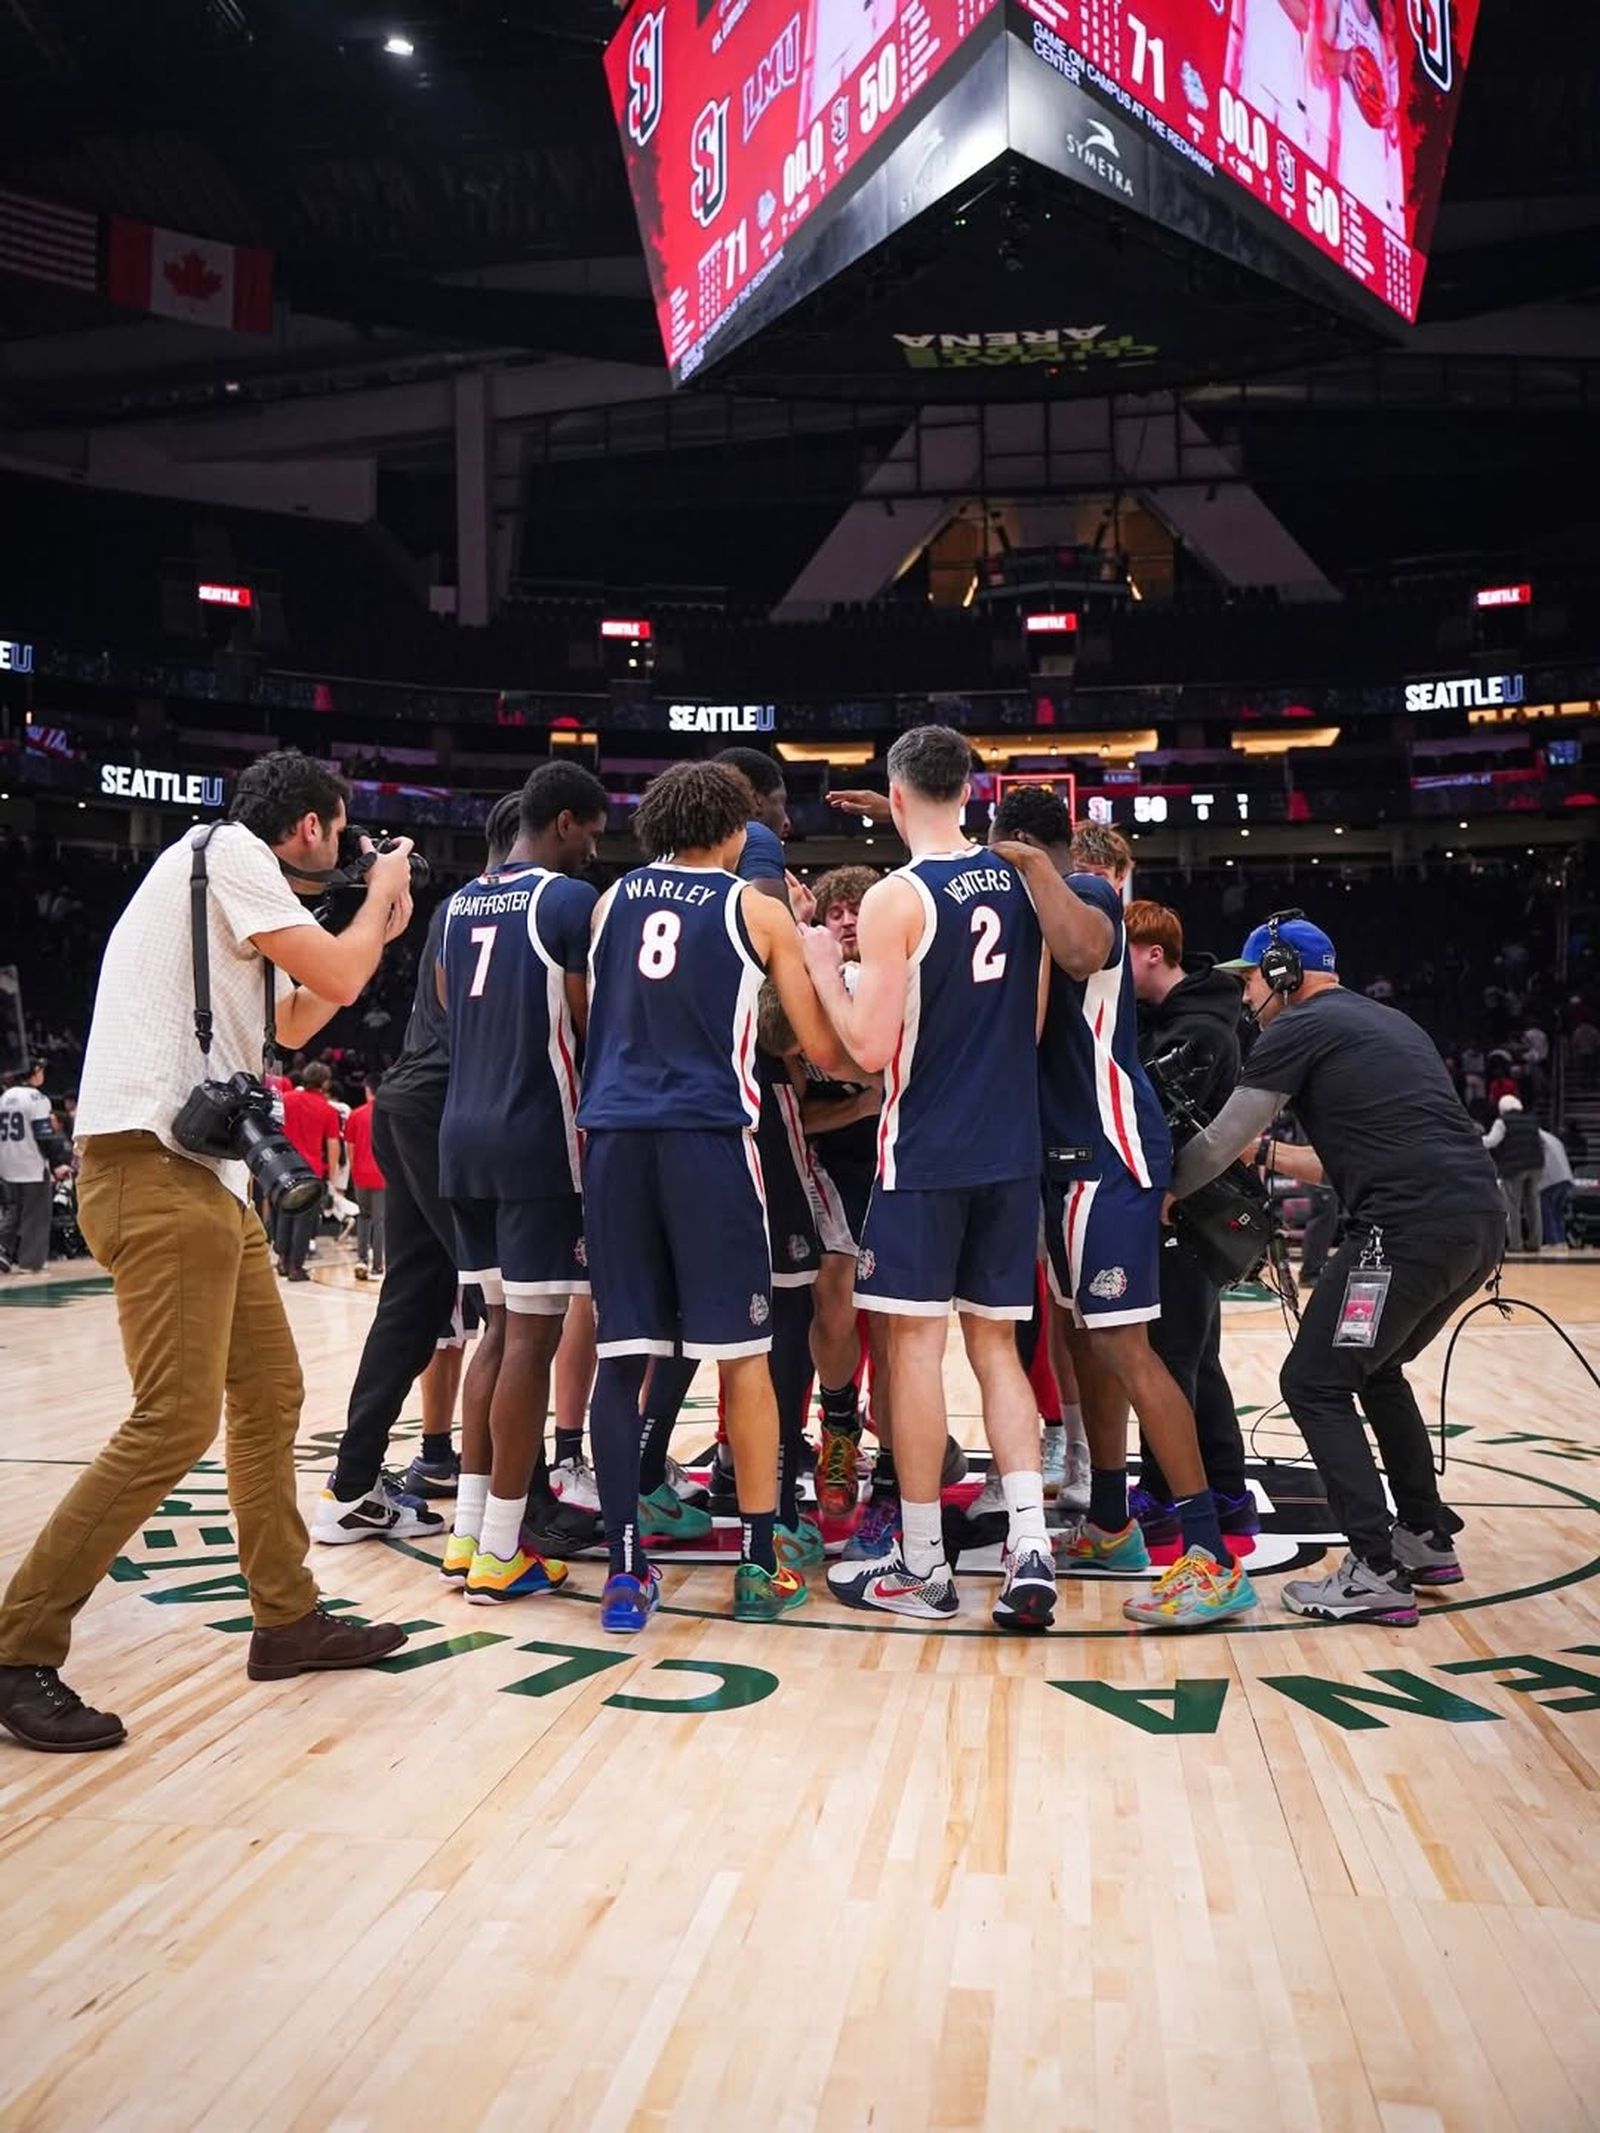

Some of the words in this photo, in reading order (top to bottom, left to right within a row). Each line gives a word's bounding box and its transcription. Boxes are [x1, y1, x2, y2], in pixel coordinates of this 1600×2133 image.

[743, 12, 800, 144] LMU
[859, 43, 897, 134] 50
[1033, 38, 1081, 85] CENTER
[1127, 13, 1165, 103] 71
[1033, 21, 1067, 58] GAME
[1068, 49, 1085, 73] ON
[1086, 64, 1131, 110] CAMPUS
[1131, 100, 1144, 119] AT
[1145, 110, 1167, 138] THE
[1166, 130, 1215, 177] REDHAWK
[1219, 86, 1269, 172] 00.0
[783, 120, 824, 207] 00.0
[1066, 132, 1134, 197] SYMETRA
[1305, 169, 1341, 247] 50
[724, 217, 747, 290] 71
[893, 324, 1107, 348] ARENA
[669, 705, 775, 732] SEATTLEU
[1405, 675, 1523, 712] SEATTLEU
[101, 764, 224, 806] SEATTLEU
[625, 878, 716, 906] WARLEY
[944, 869, 1012, 904] VENTERS
[469, 925, 497, 997] 7
[638, 909, 681, 979] 8
[970, 905, 1007, 983] 2
